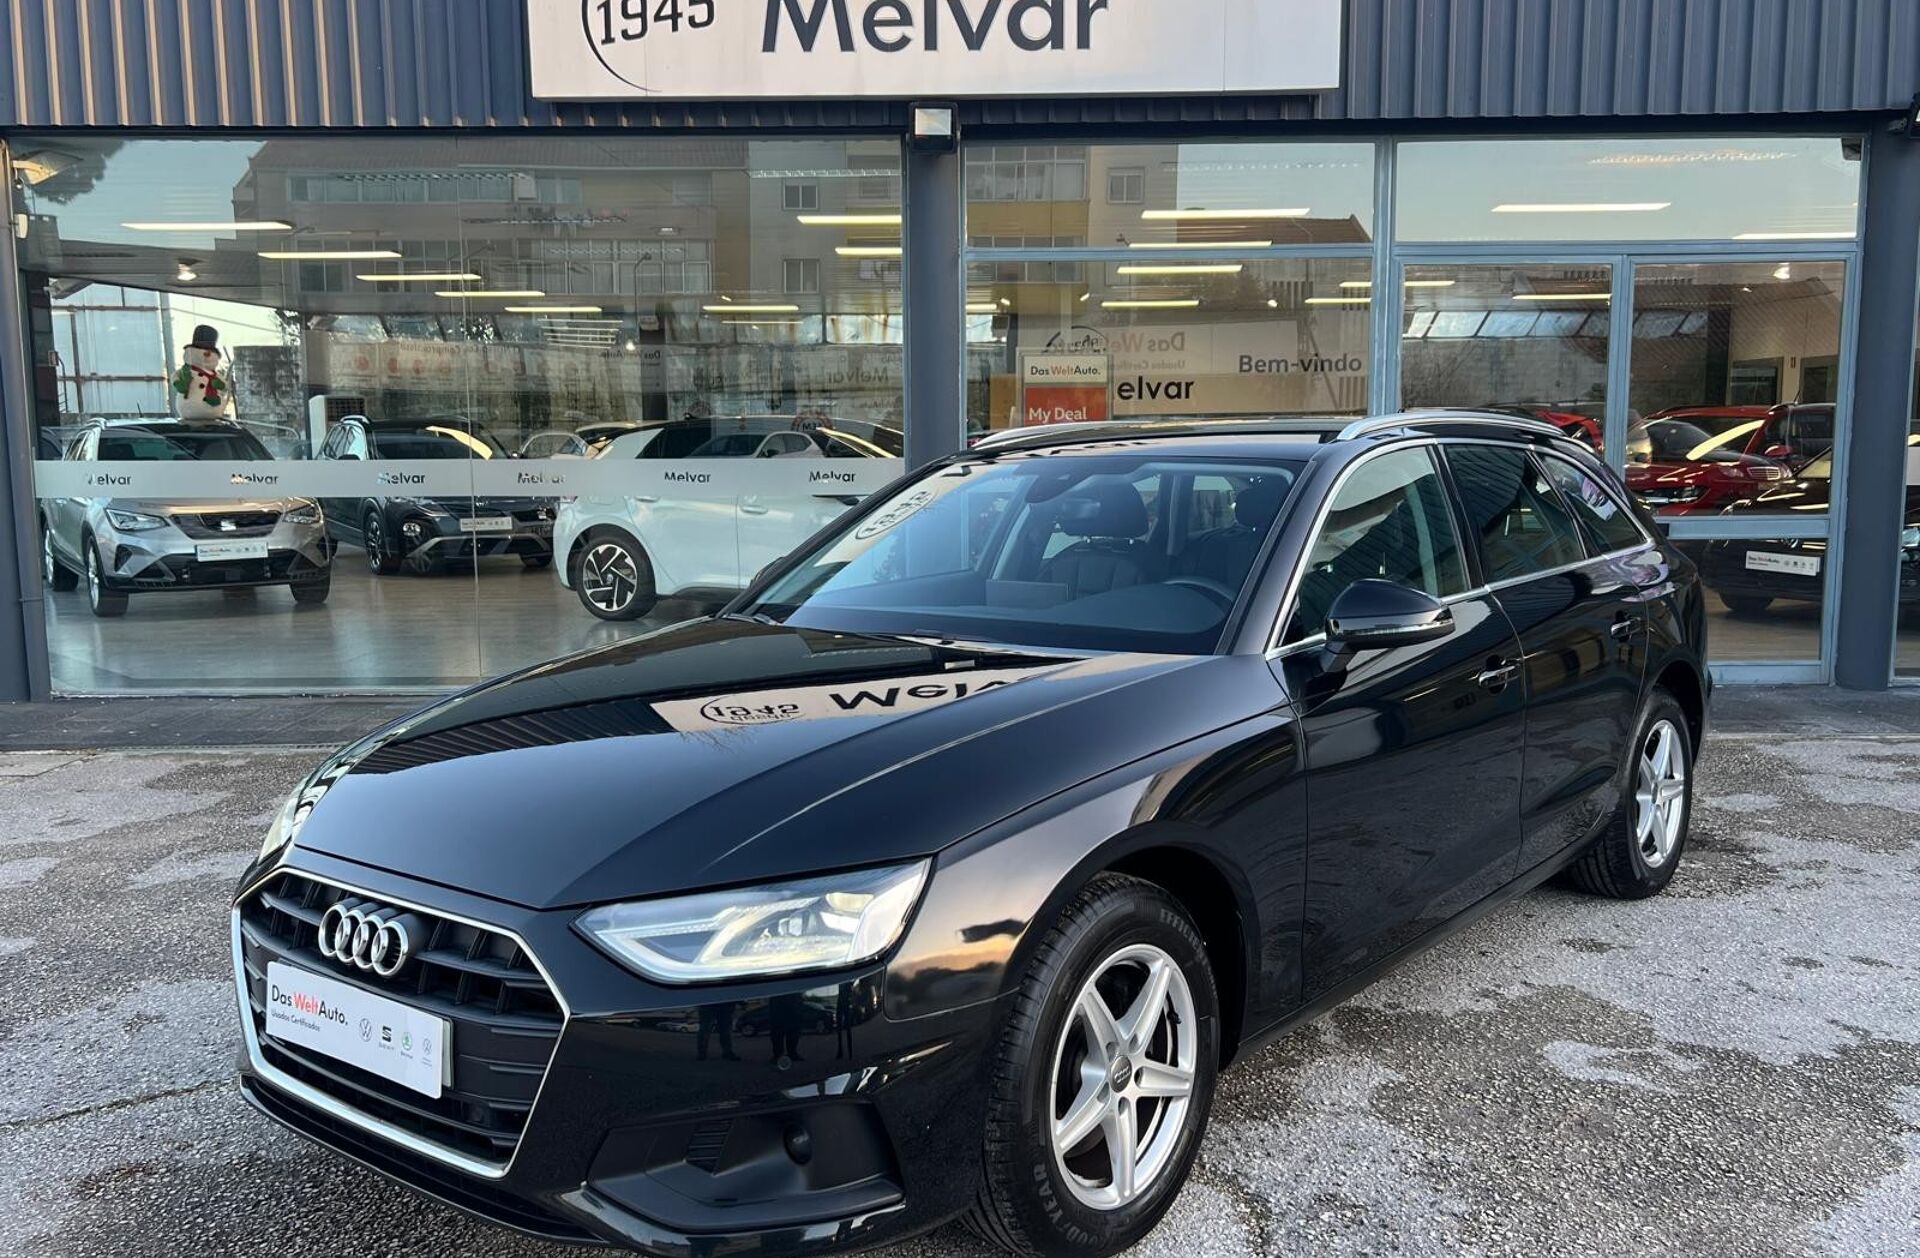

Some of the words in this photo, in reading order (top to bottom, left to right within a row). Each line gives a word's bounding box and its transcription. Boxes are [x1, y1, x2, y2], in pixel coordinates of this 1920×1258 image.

[597, 0, 714, 45] 1945
[762, 0, 1109, 52] Melvar
[1239, 353, 1362, 373] Bem-vindo
[1117, 375, 1194, 400] elvar
[1029, 408, 1051, 423] My
[1054, 407, 1088, 420] Deal
[664, 471, 712, 483] Melvar
